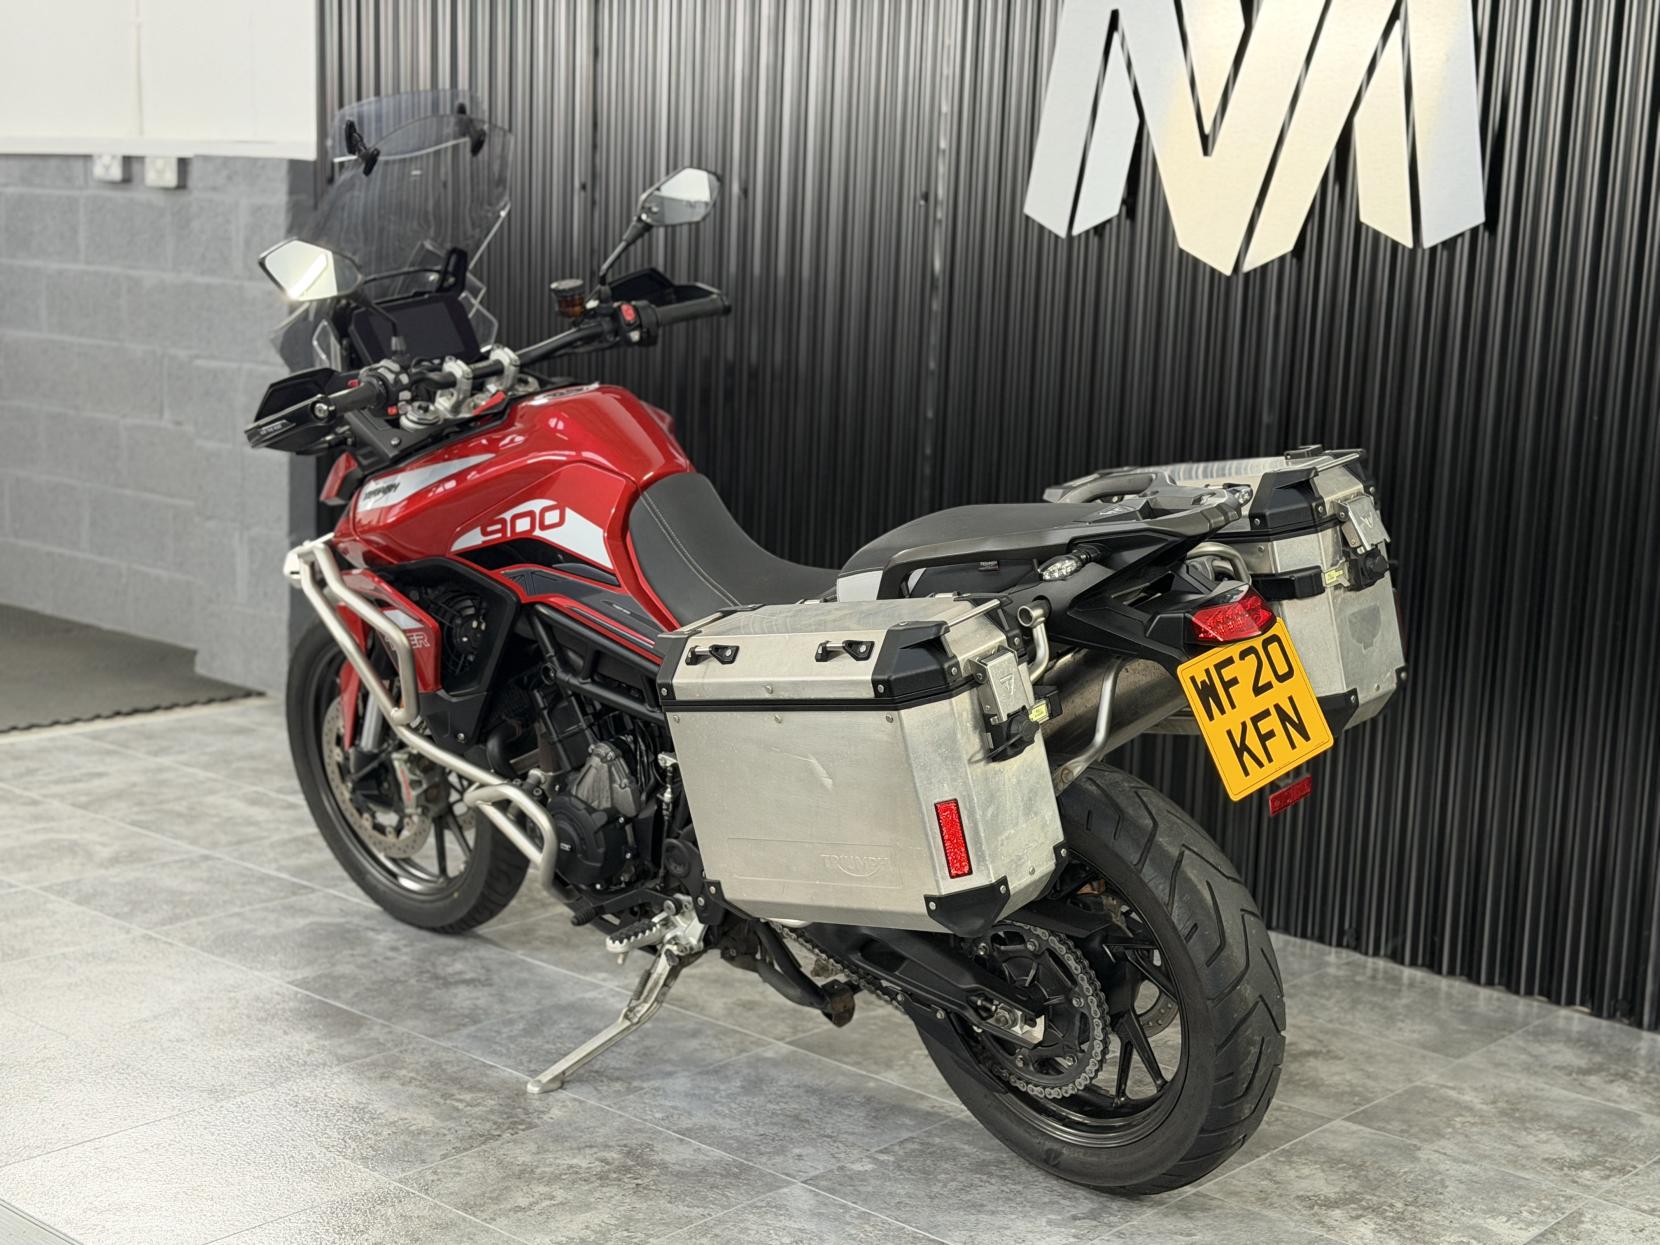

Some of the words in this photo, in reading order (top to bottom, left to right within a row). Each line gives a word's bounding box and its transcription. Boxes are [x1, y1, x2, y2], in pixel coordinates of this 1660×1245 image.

[480, 504, 566, 544] 900
[1189, 633, 1295, 722] WF20
[1226, 695, 1311, 778] KFN
